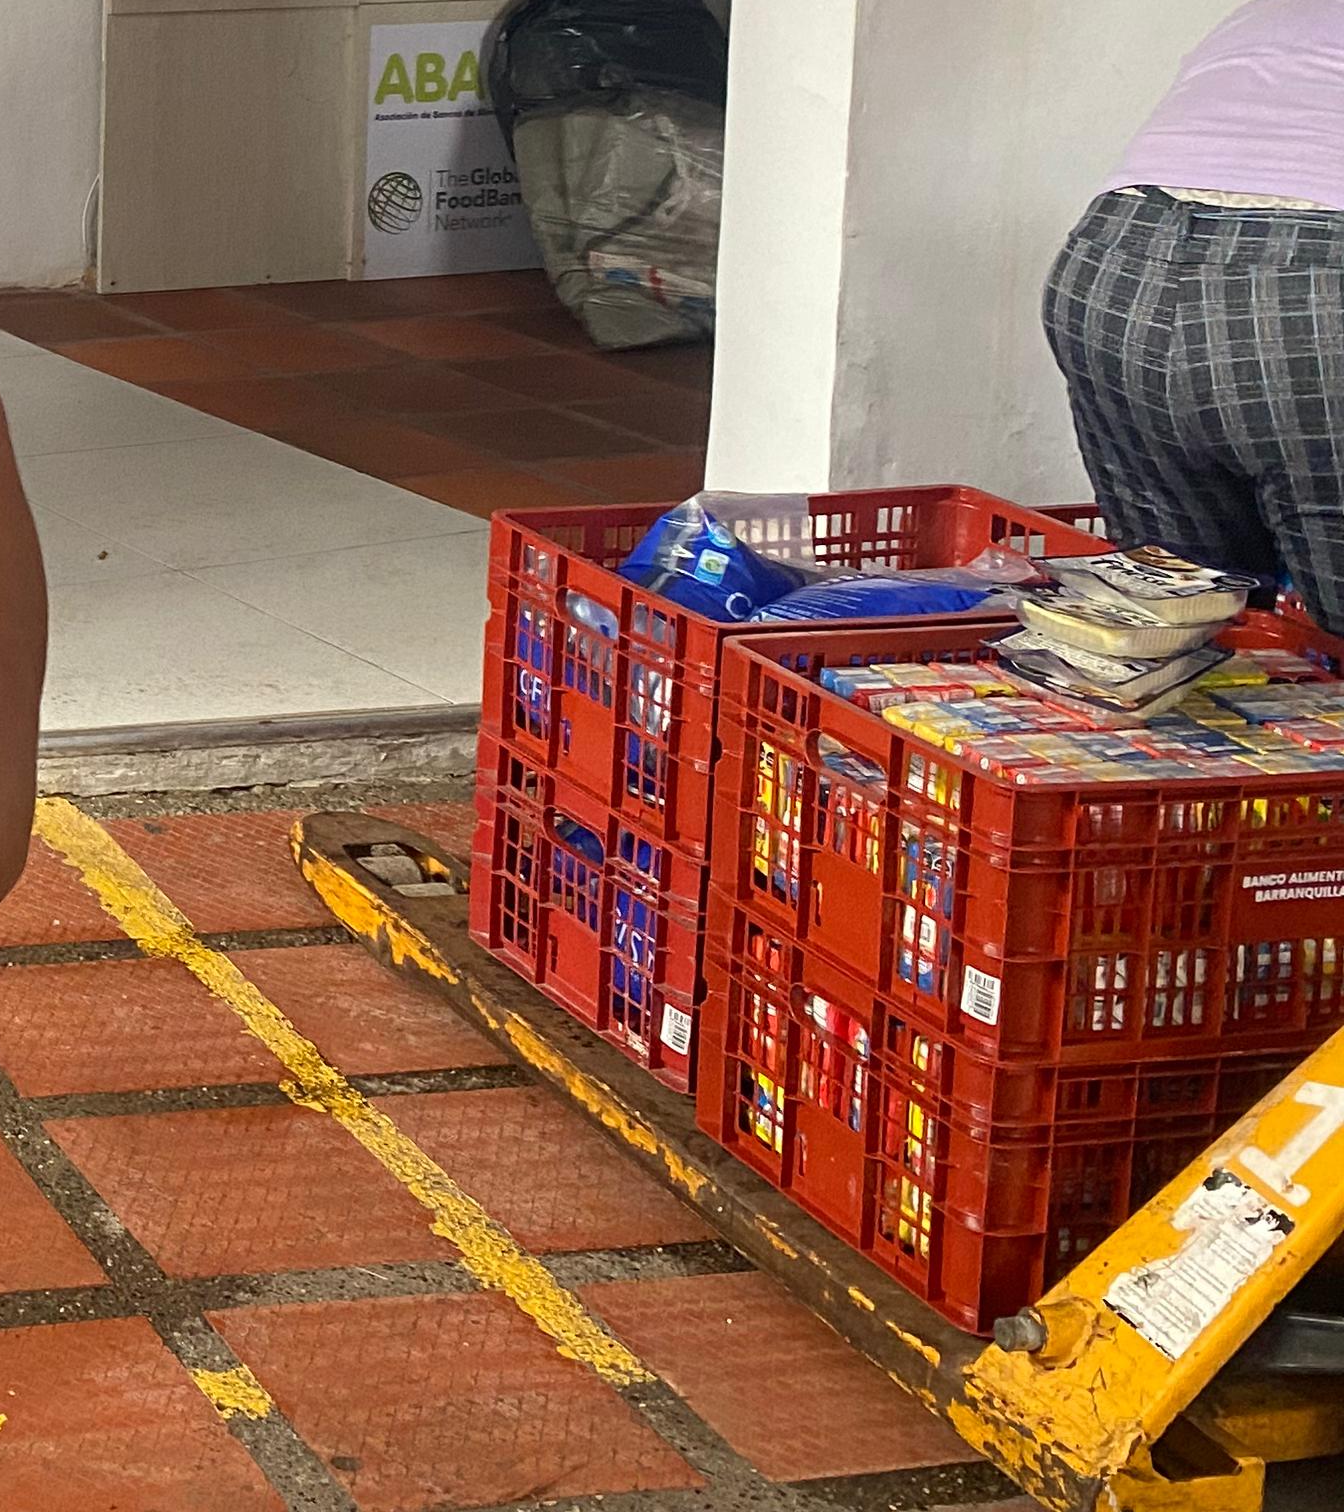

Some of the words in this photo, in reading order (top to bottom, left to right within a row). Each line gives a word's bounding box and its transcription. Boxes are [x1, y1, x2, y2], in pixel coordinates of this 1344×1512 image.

[374, 50, 486, 105] ABA
[434, 212, 513, 233] Network
[1242, 874, 1287, 889] BANCO
